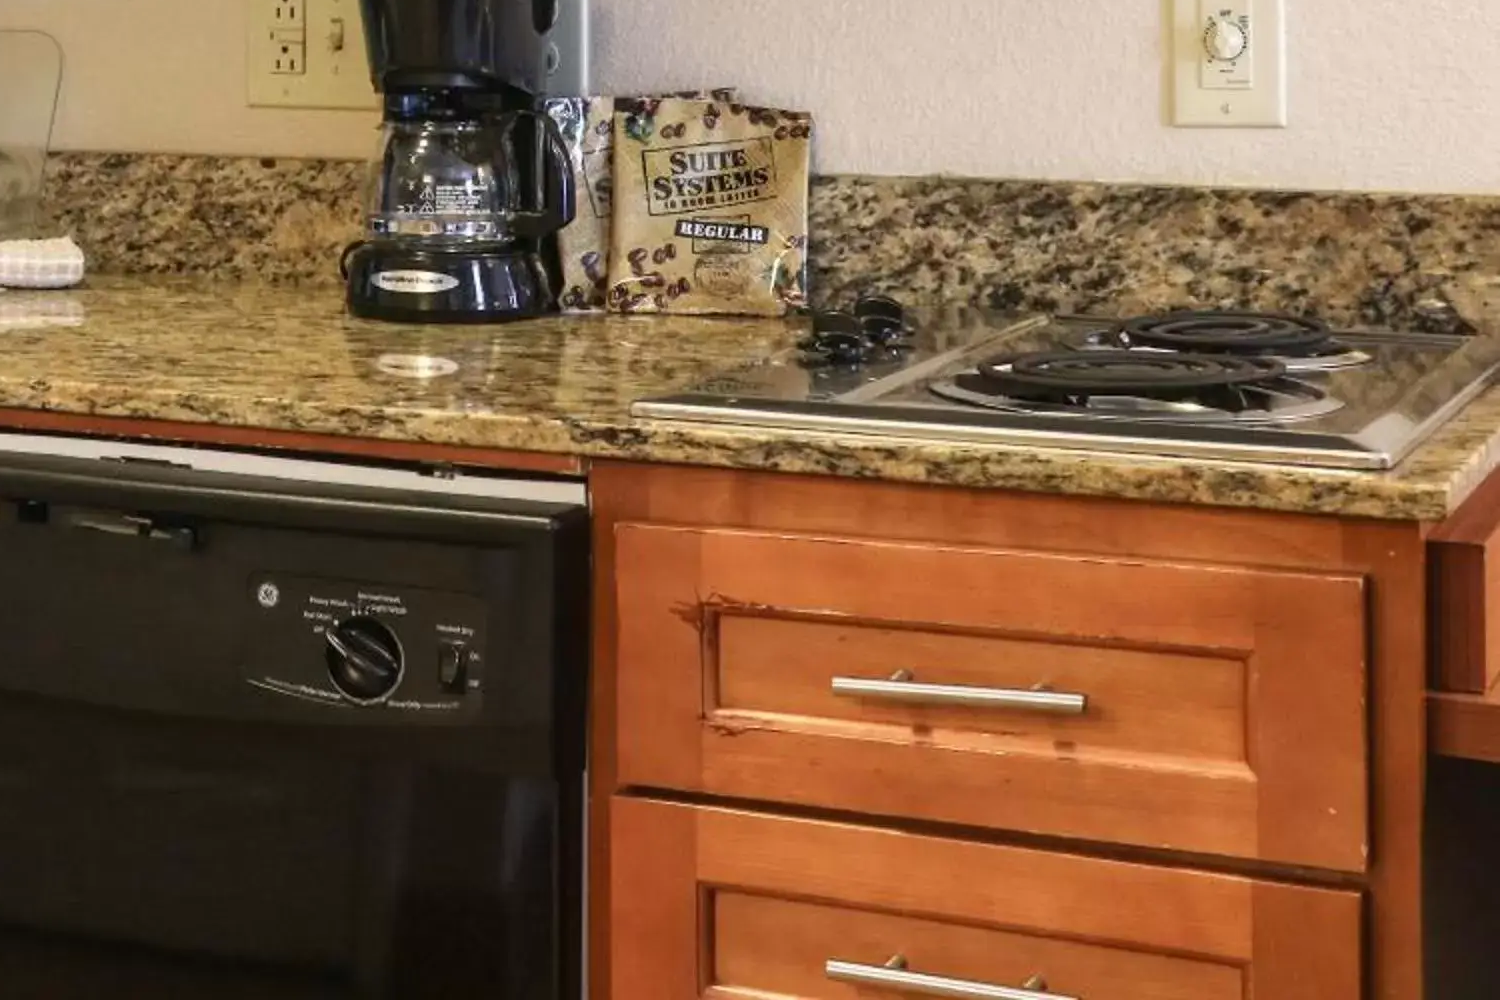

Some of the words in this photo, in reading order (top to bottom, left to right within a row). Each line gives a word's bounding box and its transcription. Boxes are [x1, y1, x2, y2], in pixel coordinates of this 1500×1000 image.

[669, 149, 748, 174] SUITE
[653, 167, 769, 200] SYSTEMS
[680, 221, 763, 241] REGULAR
